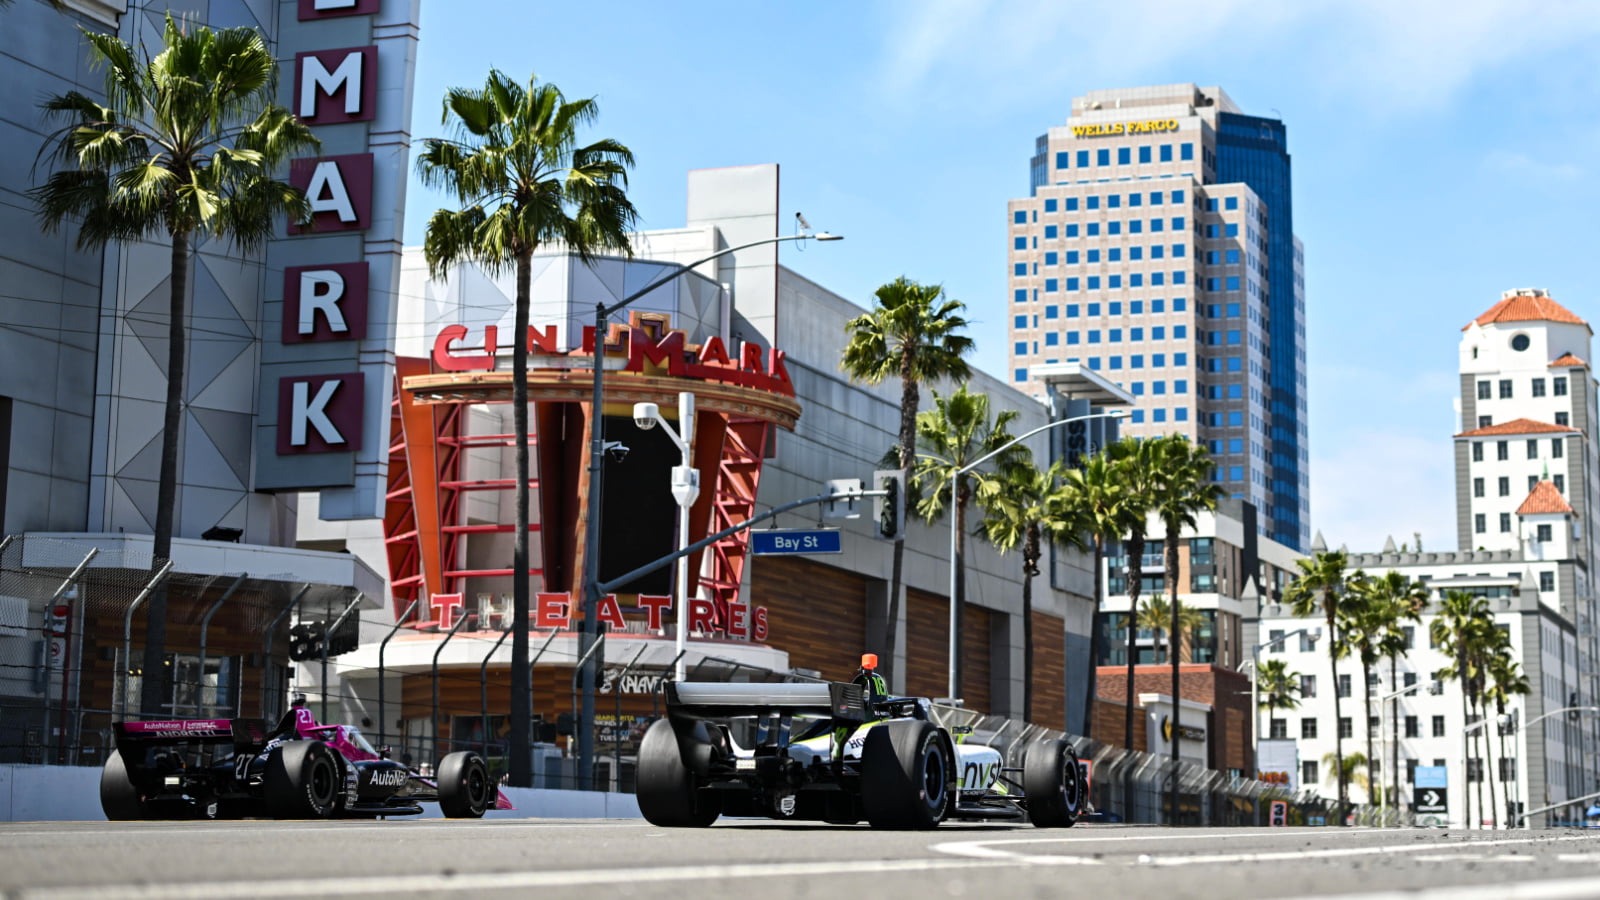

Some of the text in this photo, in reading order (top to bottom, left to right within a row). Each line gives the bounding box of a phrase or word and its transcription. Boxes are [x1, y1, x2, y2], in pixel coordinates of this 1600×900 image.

[1071, 118, 1179, 137] WELLS FARGO
[290, 0, 363, 447] MARK
[775, 536, 818, 551] Bay St
[430, 591, 769, 641] THEATRES
[297, 709, 312, 723] 27
[236, 753, 255, 780] 27
